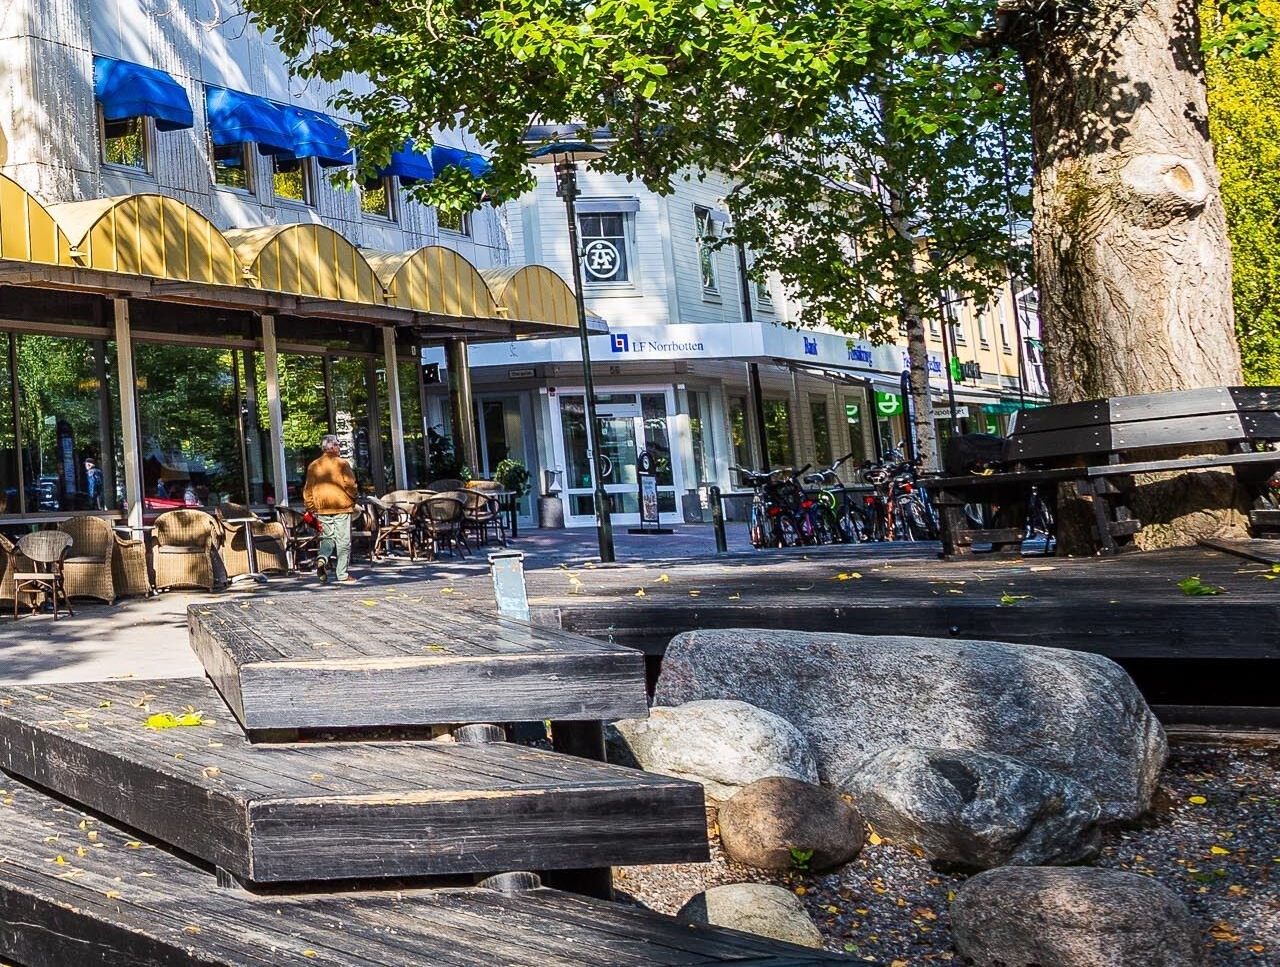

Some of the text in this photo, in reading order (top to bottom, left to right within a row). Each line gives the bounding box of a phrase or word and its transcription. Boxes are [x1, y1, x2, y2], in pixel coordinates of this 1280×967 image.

[632, 340, 705, 353] LF Norrbotten
[803, 336, 818, 355] Bank
